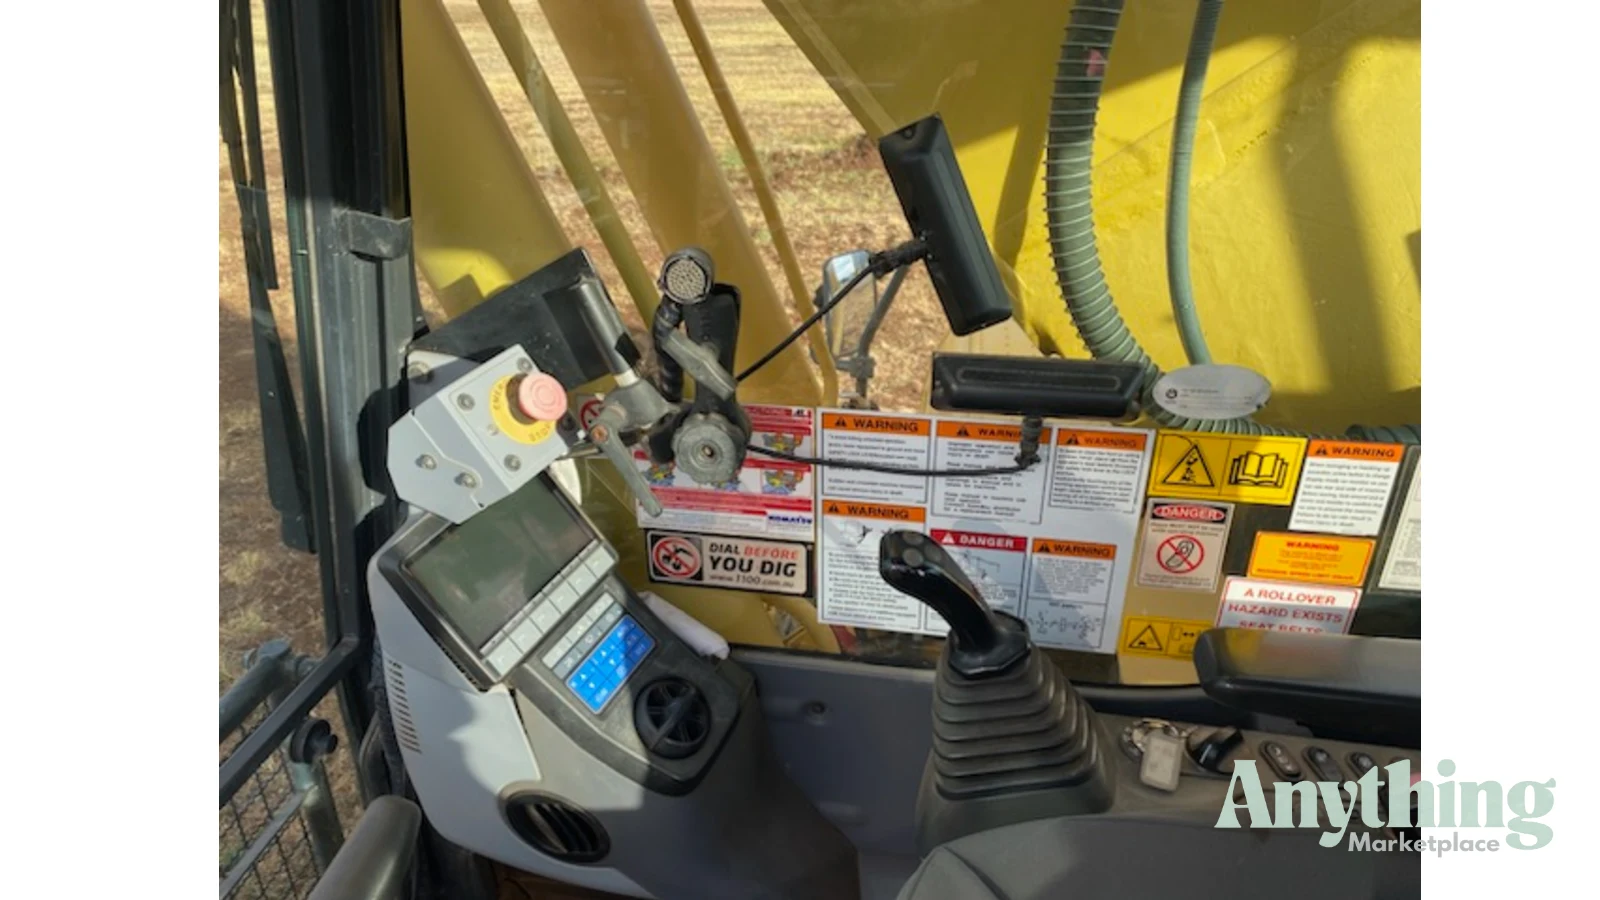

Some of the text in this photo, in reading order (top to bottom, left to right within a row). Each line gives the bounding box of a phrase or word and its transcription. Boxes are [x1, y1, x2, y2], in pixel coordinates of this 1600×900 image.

[853, 418, 918, 432] WARNING
[1085, 436, 1137, 447] WARNING
[1332, 446, 1395, 458] WARNING
[847, 506, 909, 519] WARNING
[1161, 506, 1217, 520] DANGER
[959, 532, 1014, 548] DANGER
[1286, 541, 1339, 551] WARNING
[709, 543, 799, 559] DIAL BEFORE
[1053, 543, 1110, 557] WARNING
[709, 556, 797, 578] YOU DIG
[1243, 588, 1336, 605] A ROLLOVER
[1227, 603, 1344, 623] HAZARD EXISTS
